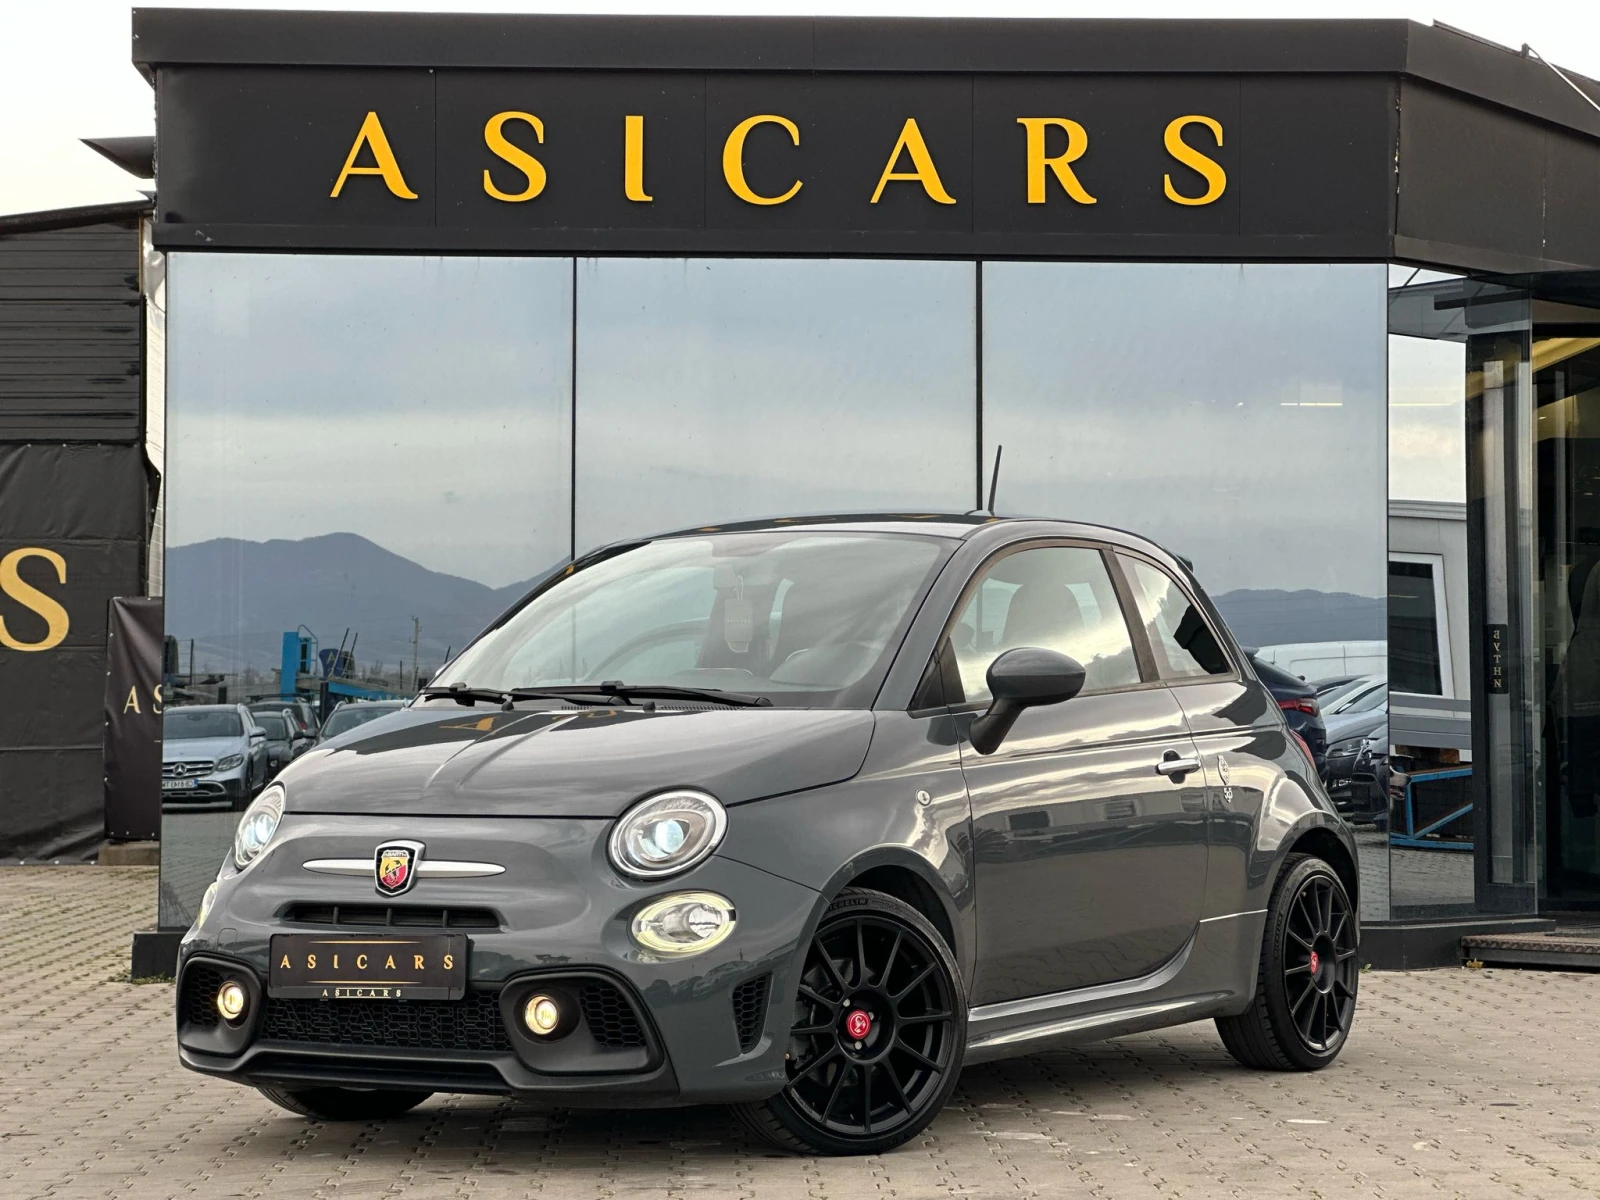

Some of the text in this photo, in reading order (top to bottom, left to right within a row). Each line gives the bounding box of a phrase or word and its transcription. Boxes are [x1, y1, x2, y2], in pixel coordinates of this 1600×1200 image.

[330, 110, 1227, 206] ASICARS
[828, 898, 866, 911] ICHELIN
[280, 954, 453, 970] ASICARS
[322, 988, 401, 998] ASICARS
